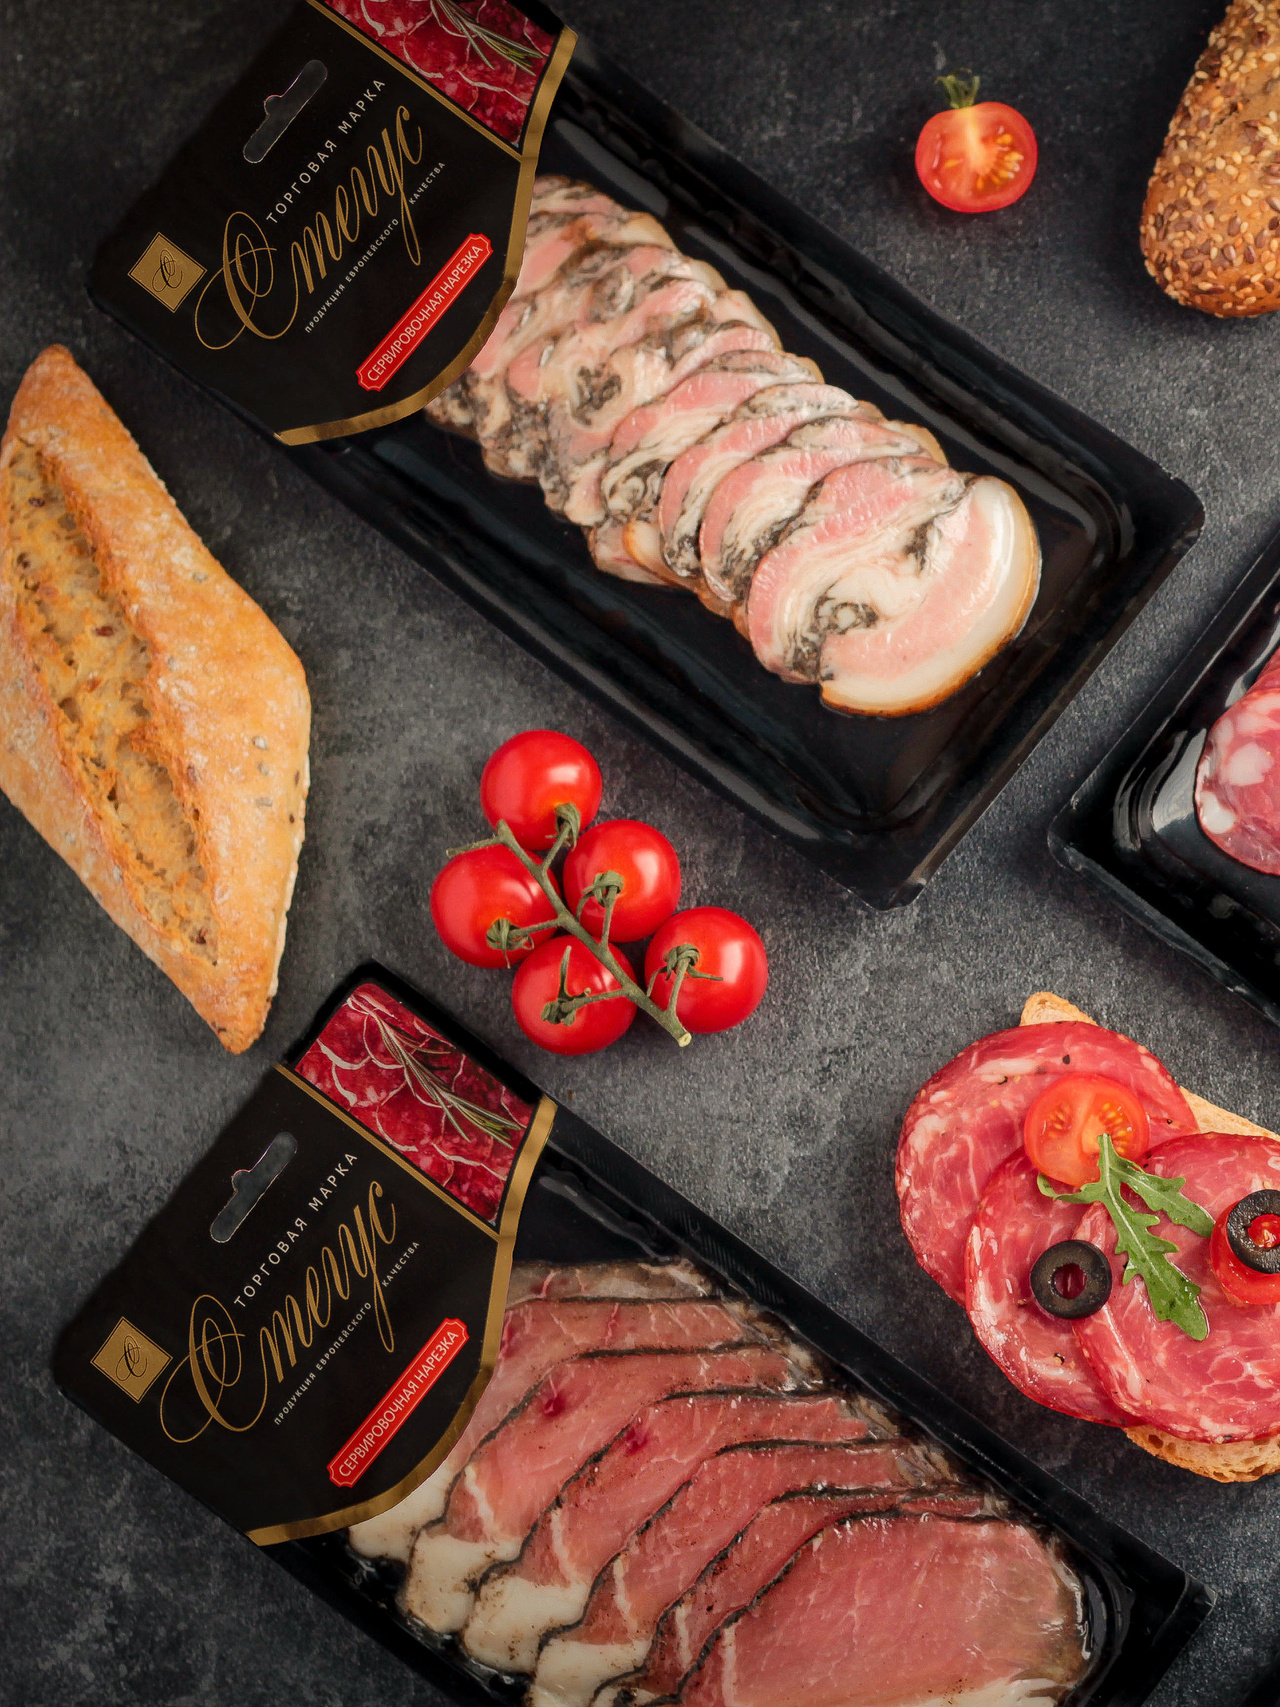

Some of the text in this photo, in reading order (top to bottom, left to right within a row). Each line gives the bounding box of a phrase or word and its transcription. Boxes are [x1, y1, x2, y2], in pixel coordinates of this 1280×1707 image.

[267, 80, 385, 224] ТОРГОВАЯ МАРКА
[305, 162, 445, 332] ПРОДУКЦИЯ ЕВРОПЕЙСКОГО КАЧЕСТВА
[368, 245, 482, 381] СЕРВИРОВОЧНАЯ НАРЕЗКА
[234, 1154, 357, 1307] ТОРГОВАЯ МАРКА
[274, 1241, 420, 1426] ПРОДУКЦИЯ ЕВРОПЕЙСКОГО КАЧЕСТВА
[339, 1329, 459, 1478] СЕРВИРОВОЧНАЯ НАРЕЗКА
